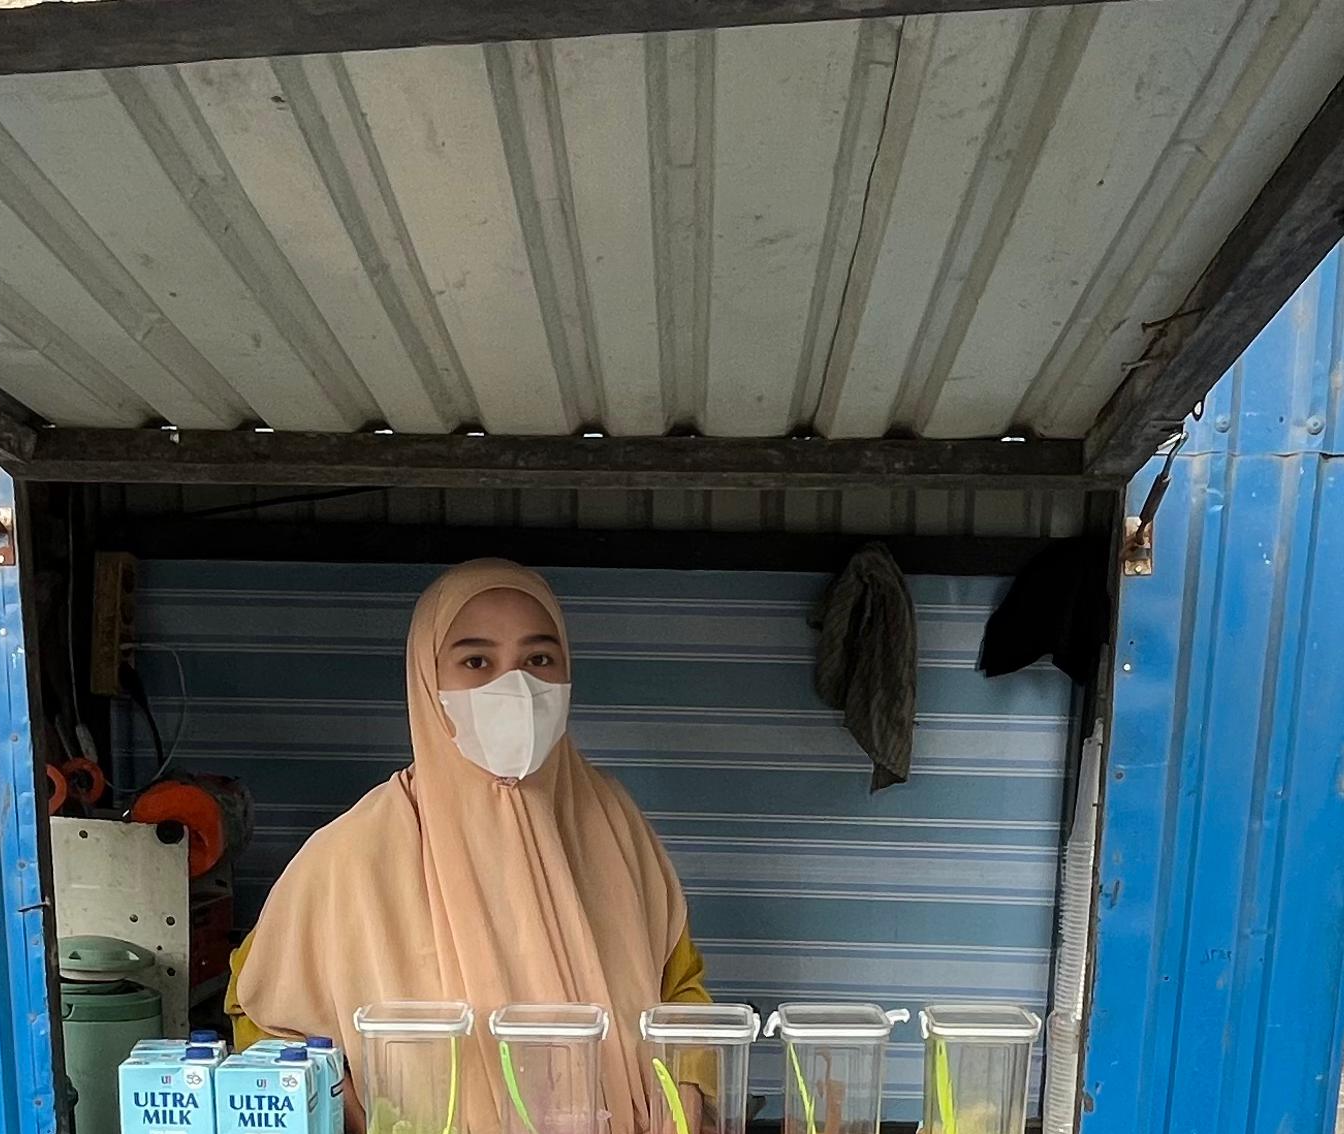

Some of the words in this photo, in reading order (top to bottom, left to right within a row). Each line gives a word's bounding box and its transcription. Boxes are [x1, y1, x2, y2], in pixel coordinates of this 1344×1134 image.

[133, 1092, 199, 1109] ULTRA
[229, 1095, 295, 1112] ULTRA
[142, 1109, 192, 1125] MILK
[238, 1112, 287, 1129] MILK
